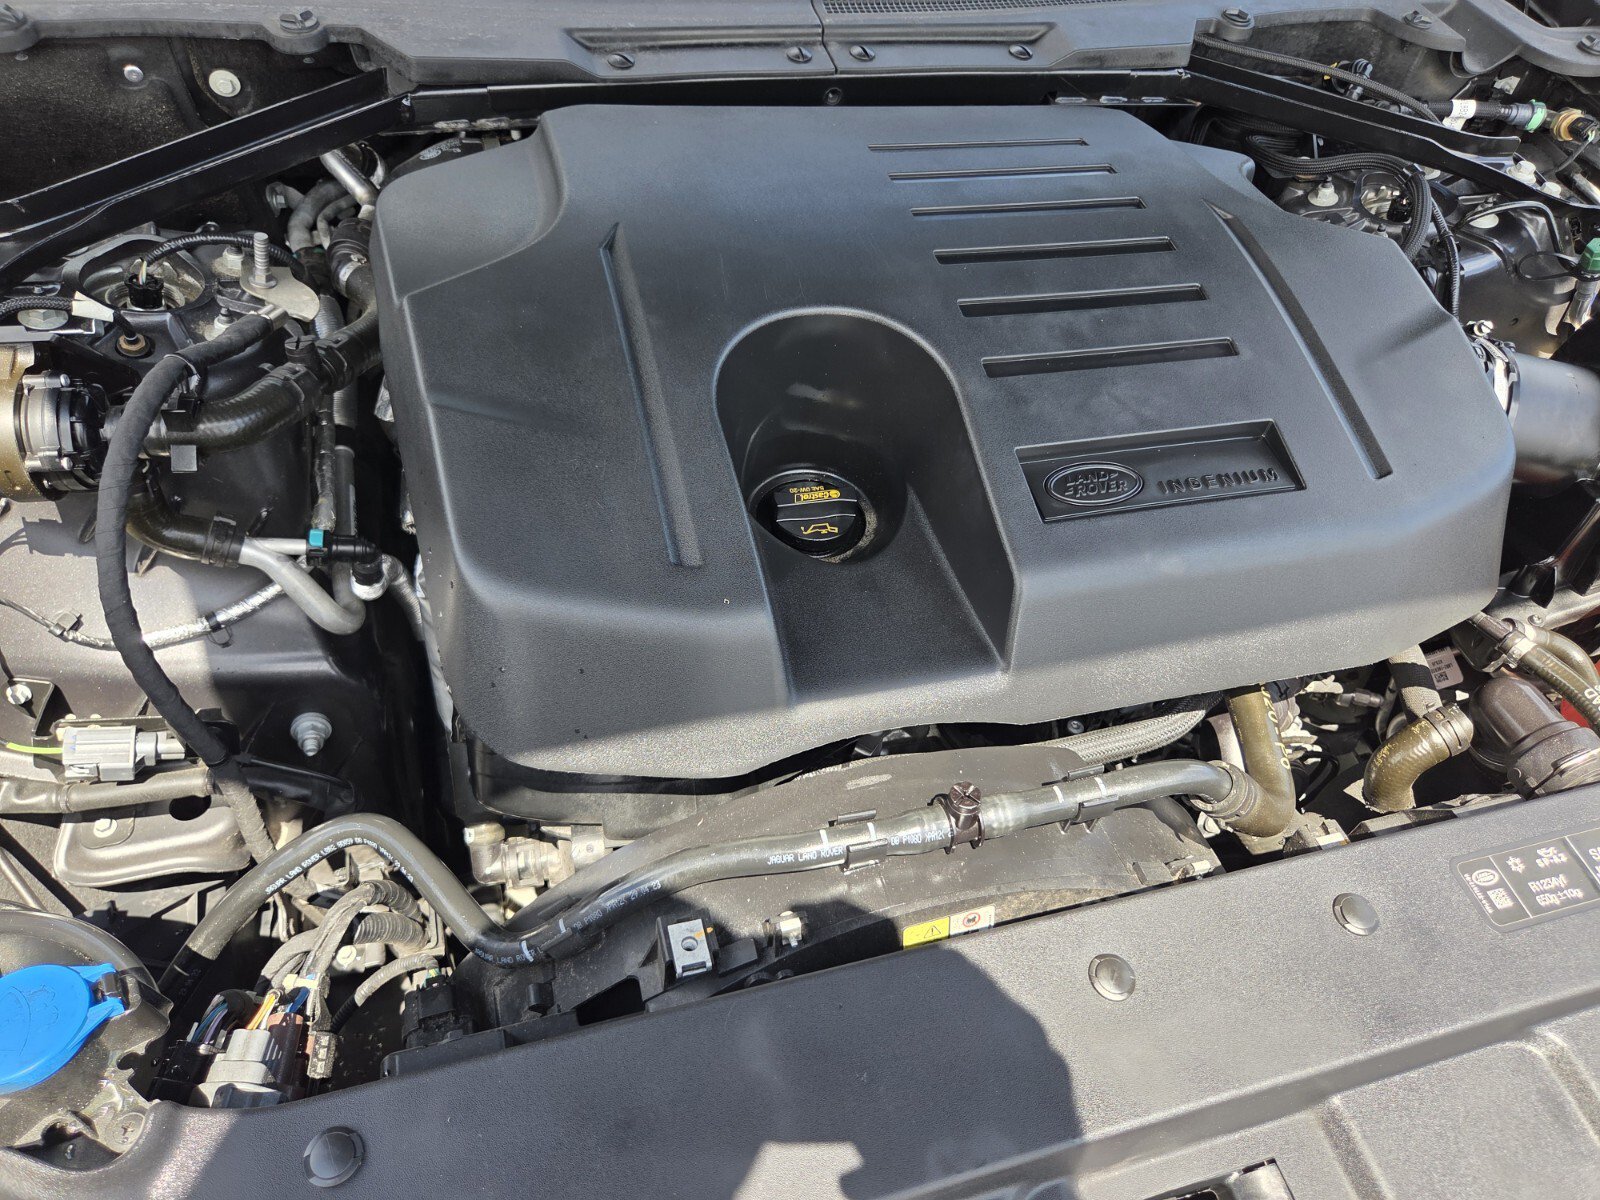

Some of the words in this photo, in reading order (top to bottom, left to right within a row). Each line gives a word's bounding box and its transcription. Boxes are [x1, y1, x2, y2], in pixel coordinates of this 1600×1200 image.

[1066, 471, 1113, 487] LAND
[1157, 467, 1281, 495] INGENIUM
[800, 491, 830, 502] Castrol
[1072, 480, 1128, 498] ROVER
[767, 854, 795, 865] JAGUAR
[798, 851, 818, 862] LAND
[821, 846, 844, 858] ROVER
[286, 866, 303, 880] LAND
[302, 853, 322, 868] ROVER
[497, 956, 514, 964] LAND
